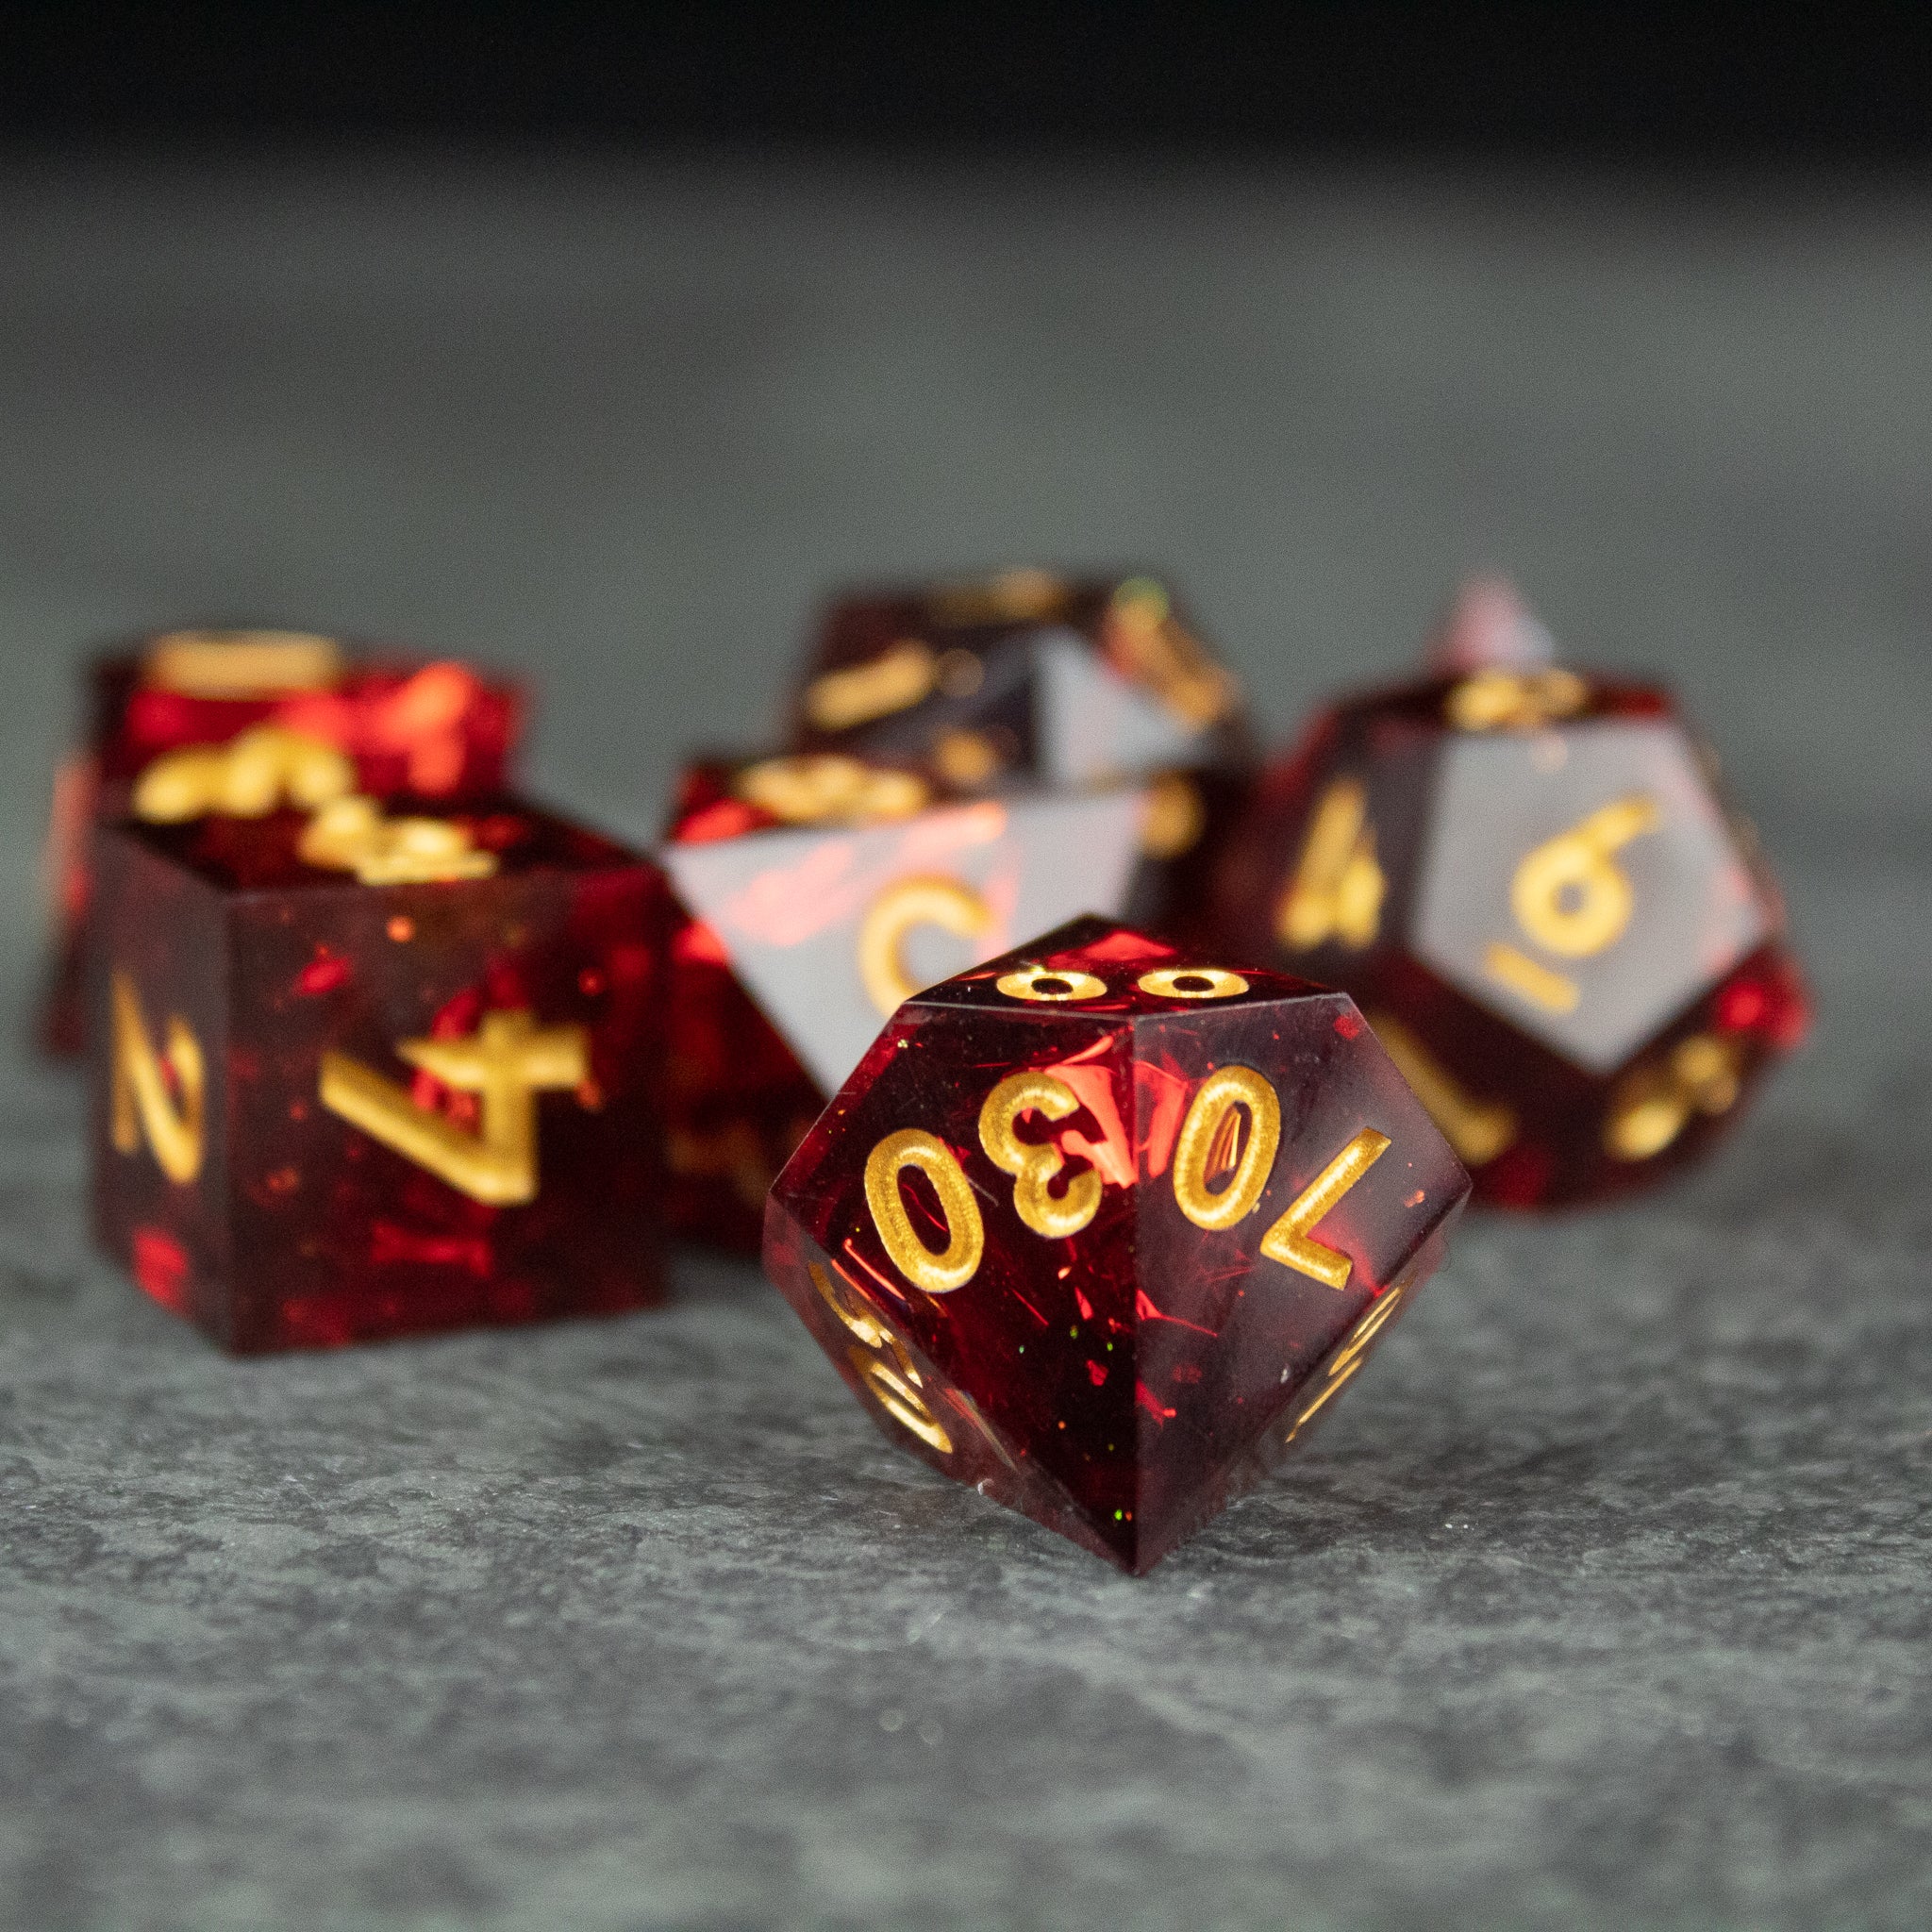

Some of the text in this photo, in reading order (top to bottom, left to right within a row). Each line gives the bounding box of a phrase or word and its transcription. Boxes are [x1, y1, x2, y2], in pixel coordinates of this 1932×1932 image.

[996, 969, 1250, 1001] 00
[319, 1009, 588, 1208] 4
[864, 1071, 1103, 1293] 30
[1173, 1065, 1391, 1291] 70
